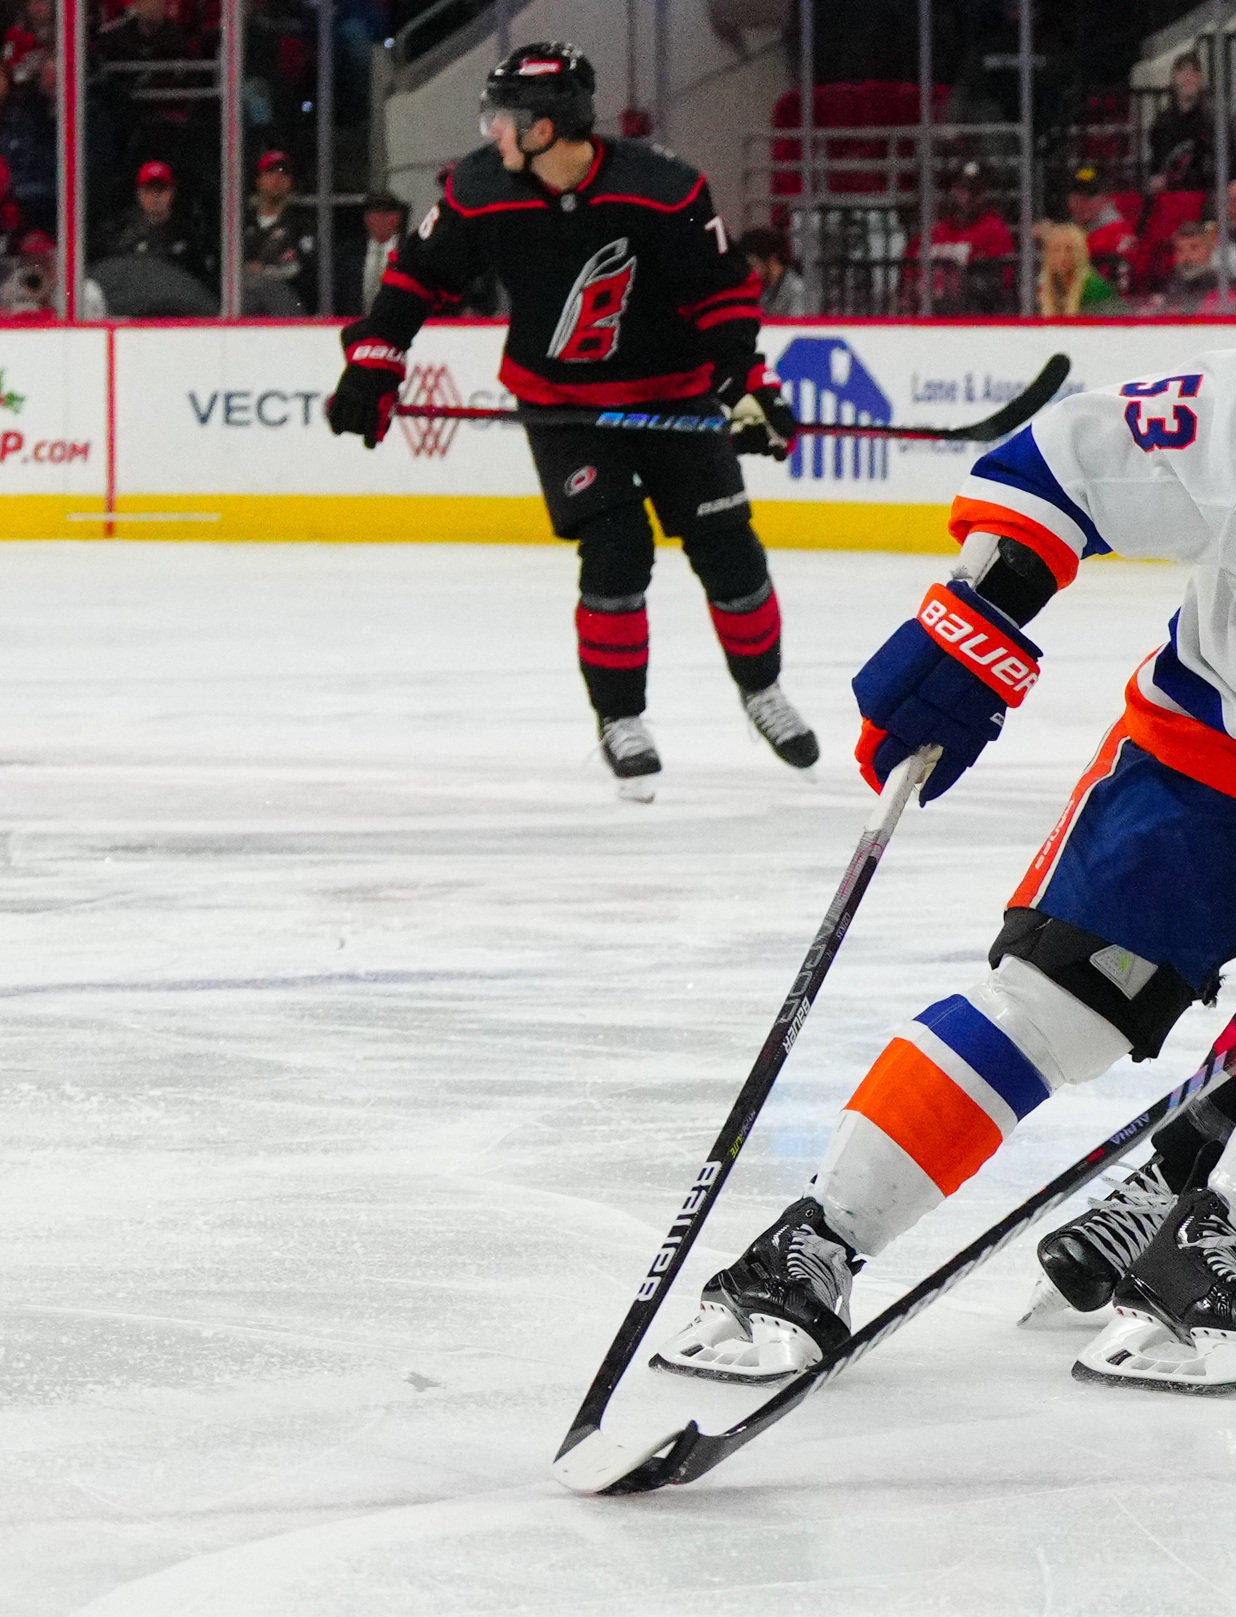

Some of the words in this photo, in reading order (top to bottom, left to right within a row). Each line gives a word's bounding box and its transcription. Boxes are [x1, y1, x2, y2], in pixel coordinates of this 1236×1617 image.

[704, 215, 729, 254] 7
[188, 389, 321, 426] VECT
[1118, 373, 1204, 453] 53
[921, 600, 1039, 697] BAUER
[782, 996, 811, 1054] BAUER
[1109, 1112, 1150, 1145] ALPHA
[635, 1160, 723, 1302] BAUER
